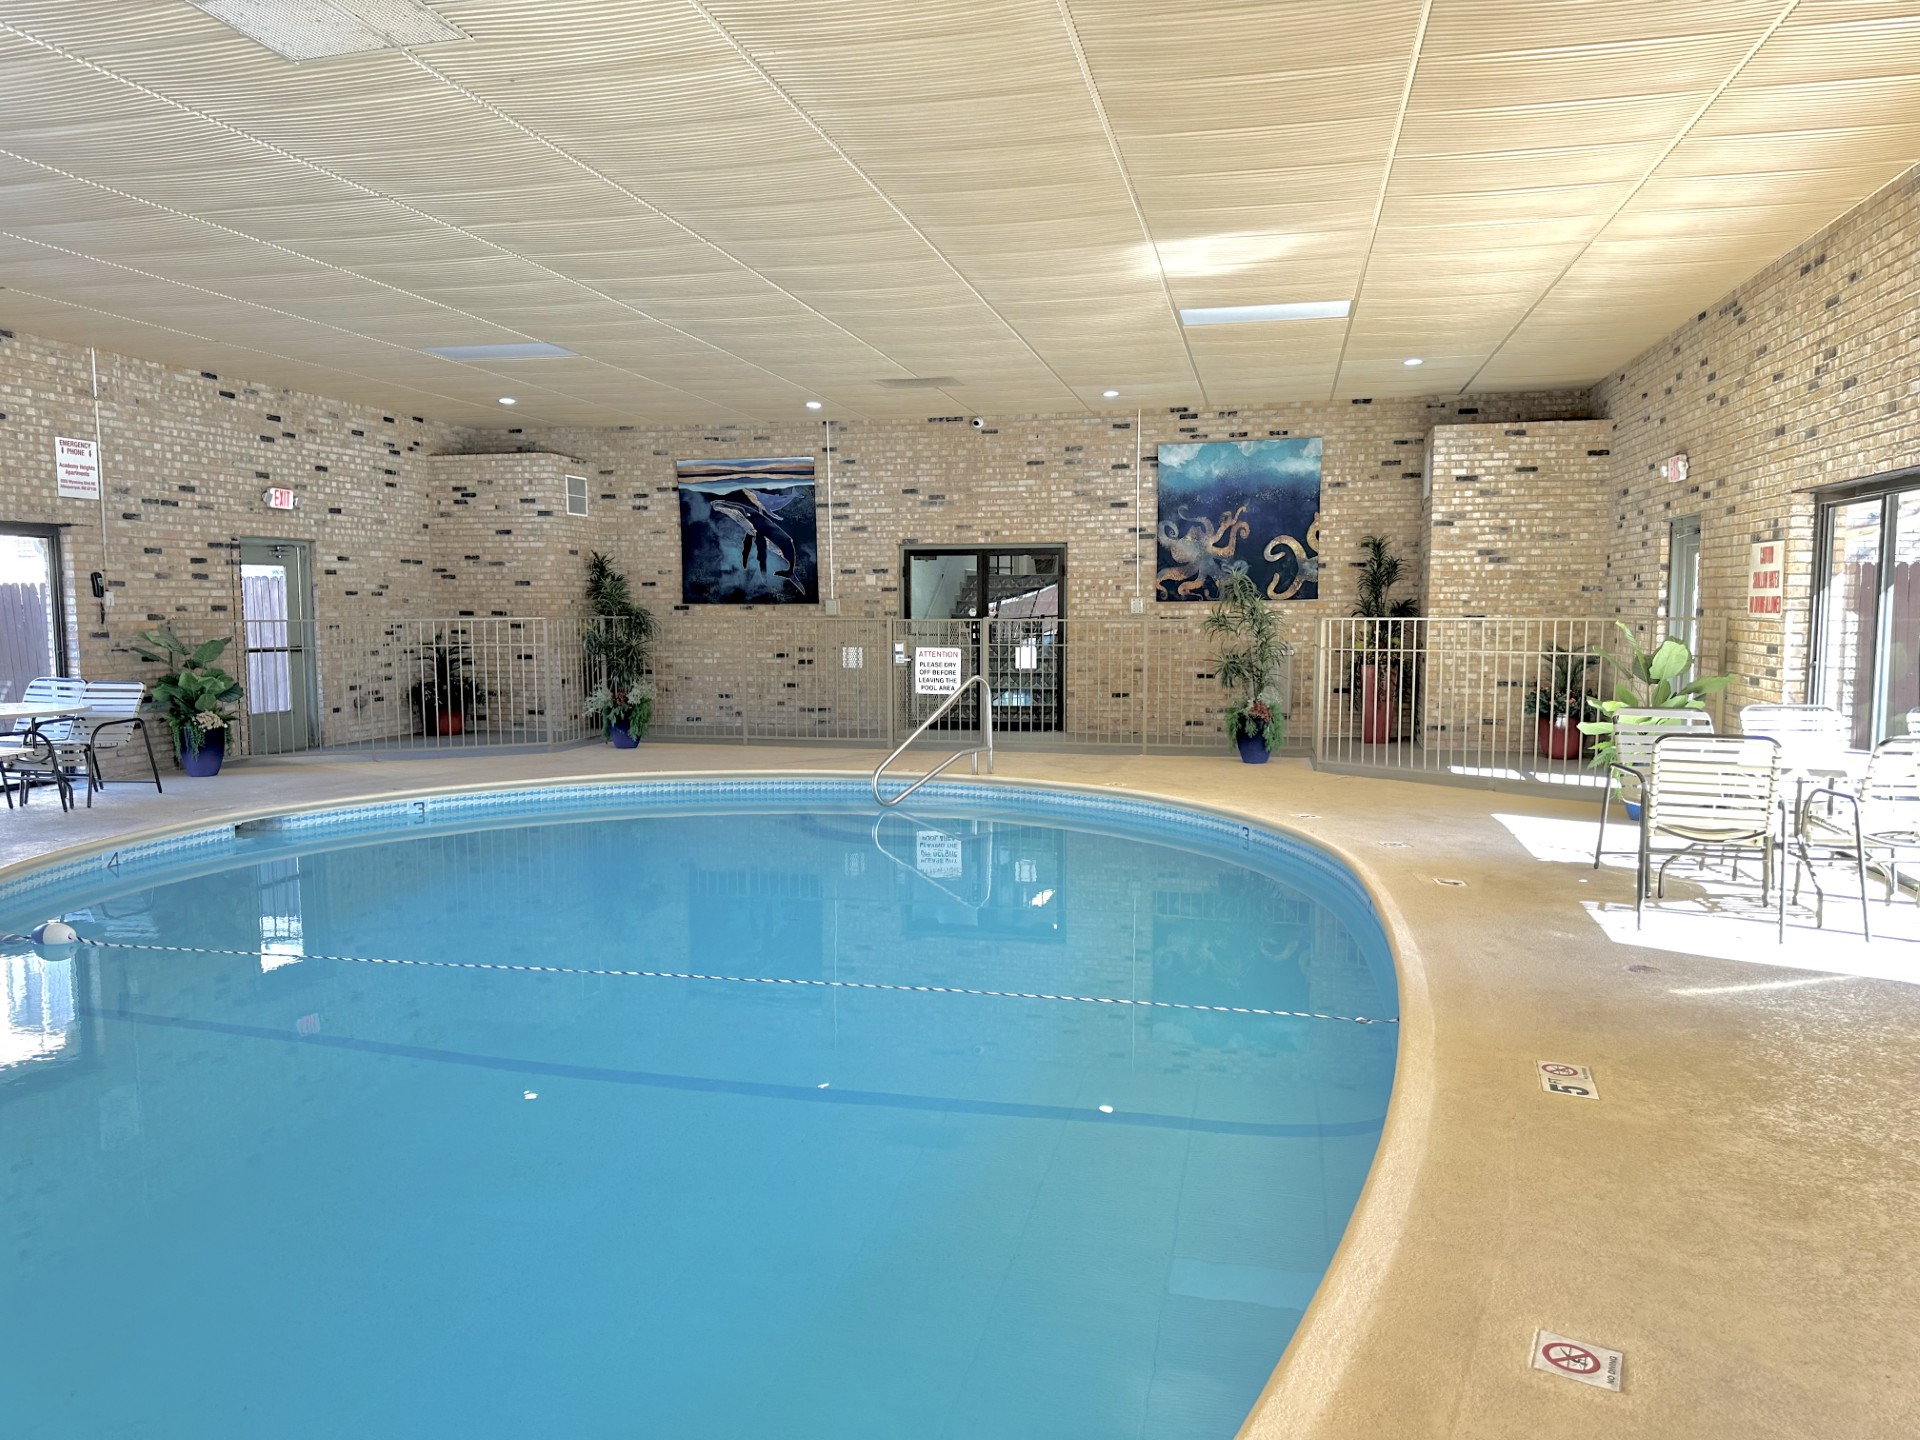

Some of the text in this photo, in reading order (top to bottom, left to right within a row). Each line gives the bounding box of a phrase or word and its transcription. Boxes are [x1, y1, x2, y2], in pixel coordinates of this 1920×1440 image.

[59, 439, 91, 449] EMERGENCY
[67, 447, 85, 456] PHONE
[59, 462, 78, 470] Academy
[65, 469, 90, 477] Apartments
[274, 489, 291, 508] EXIT
[919, 650, 959, 658] ATTENTION
[1548, 1083, 1590, 1096] 5
[1606, 1355, 1618, 1385] NO DIVING
